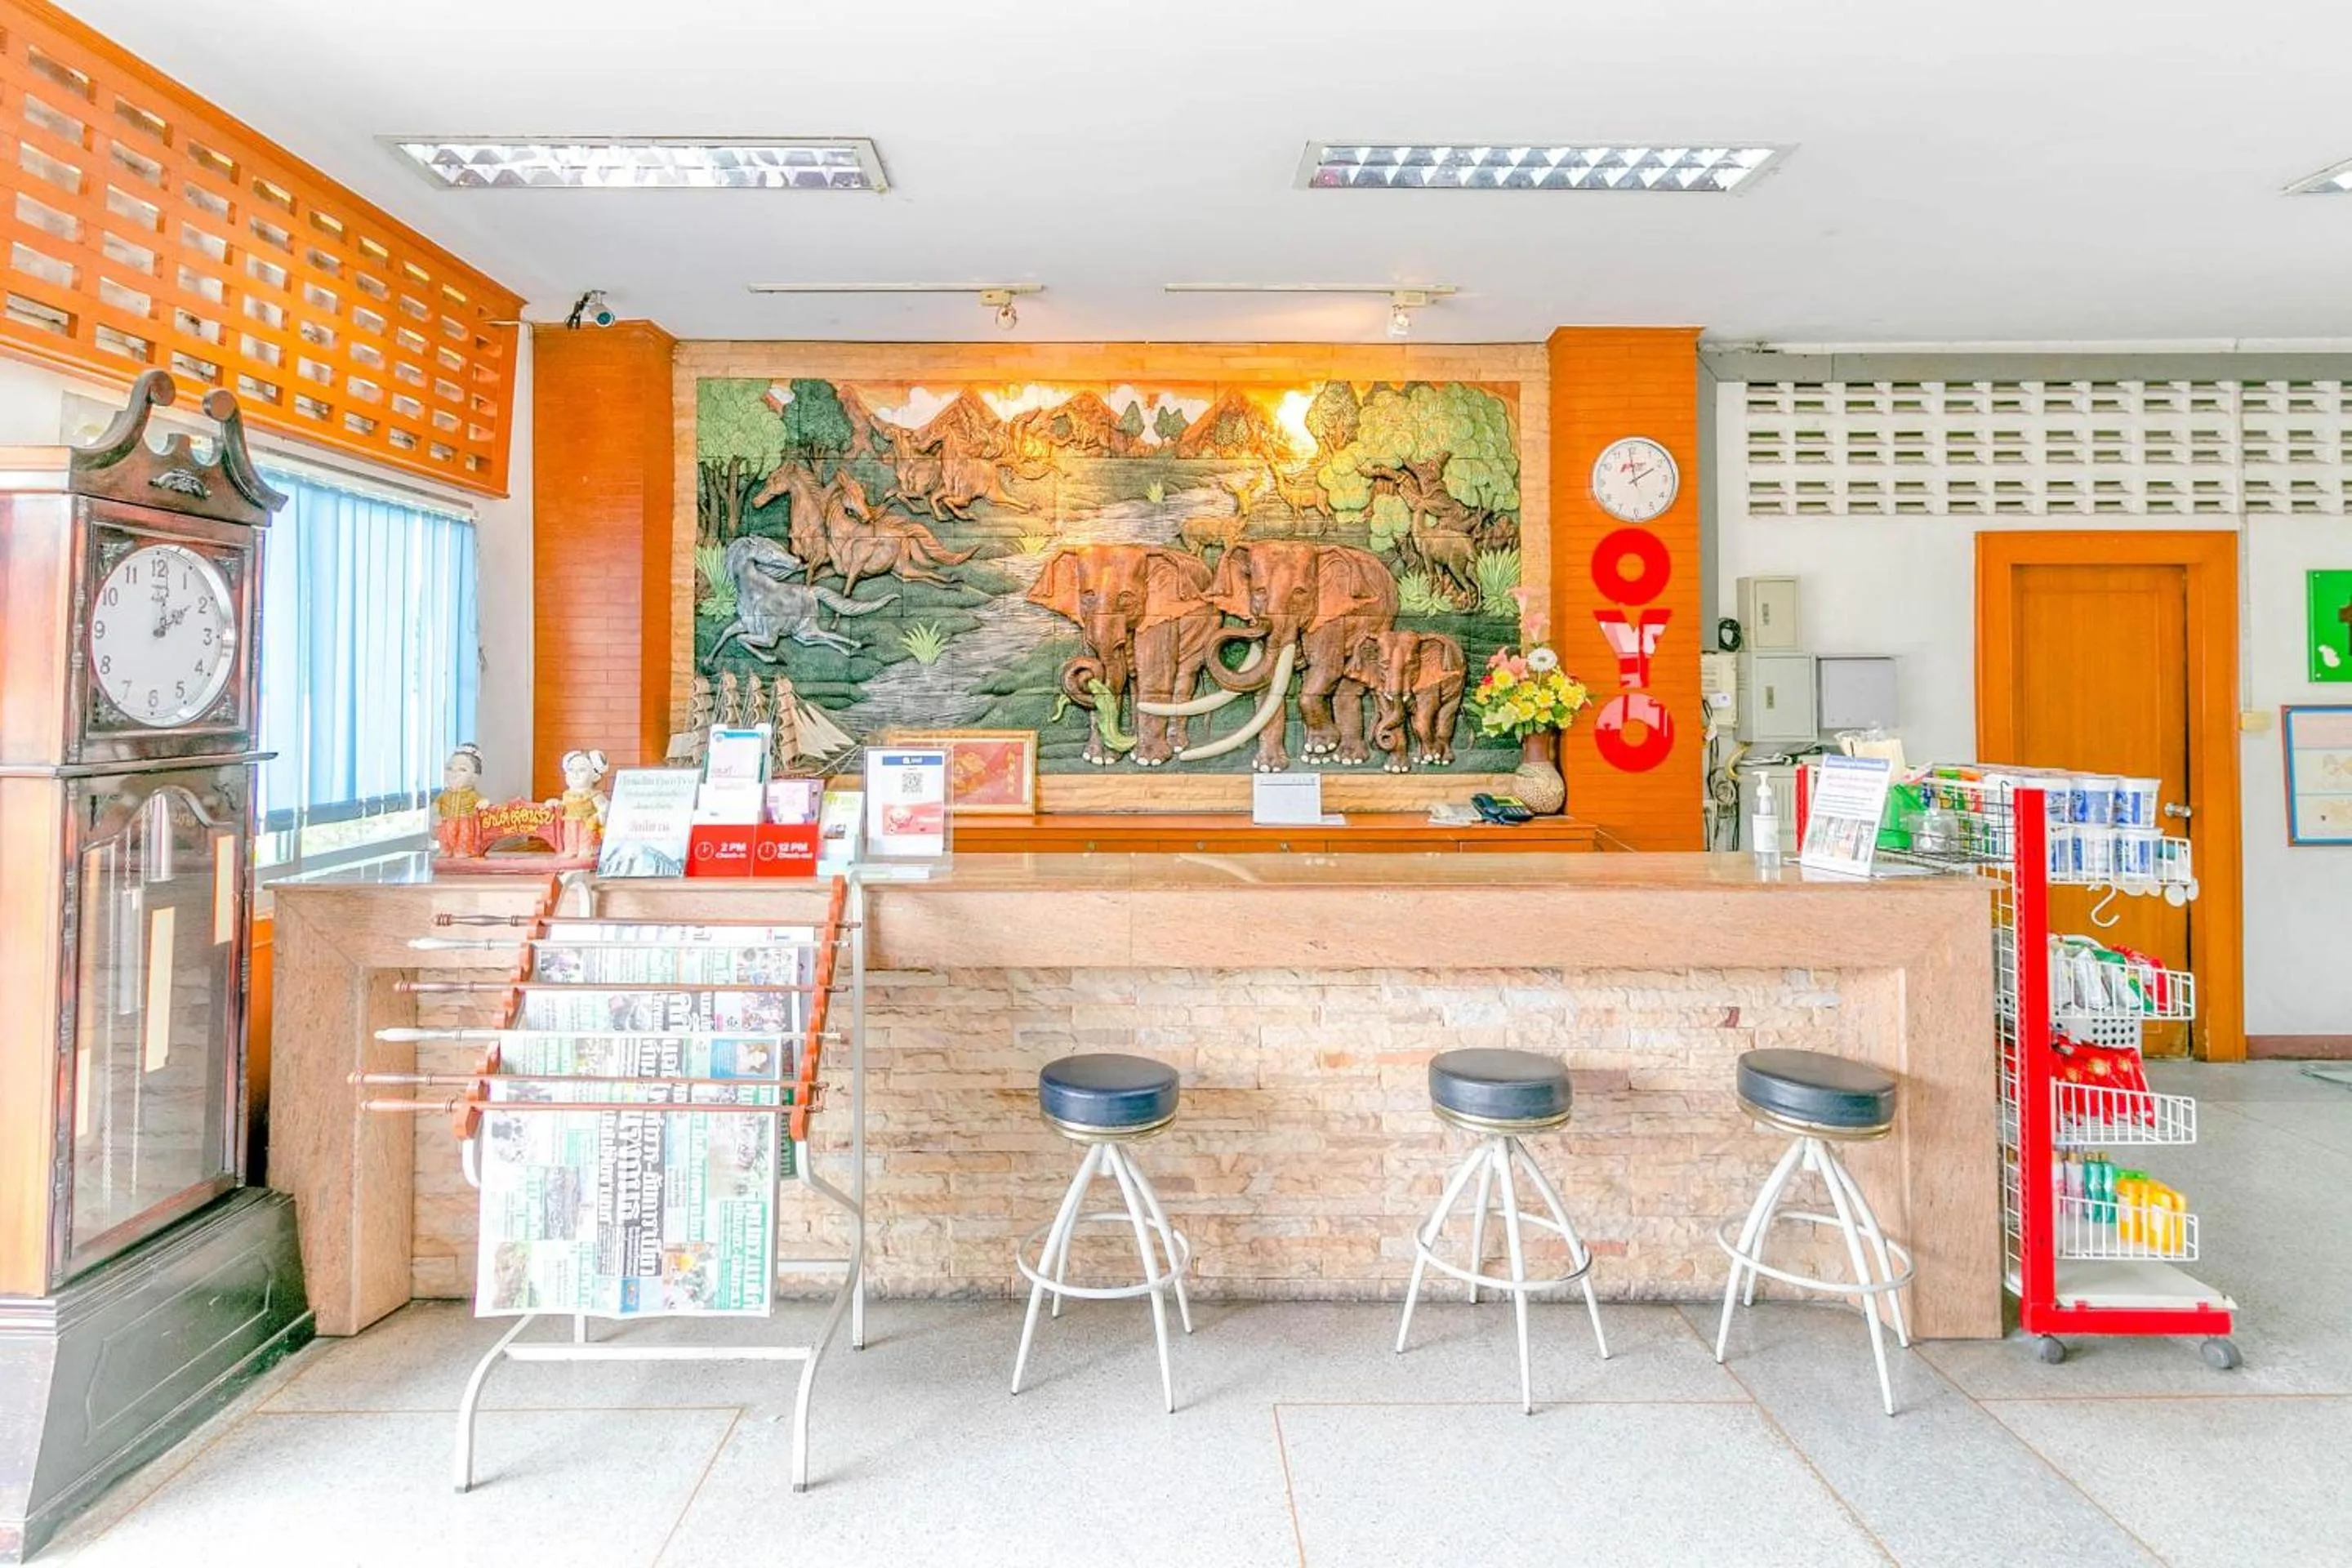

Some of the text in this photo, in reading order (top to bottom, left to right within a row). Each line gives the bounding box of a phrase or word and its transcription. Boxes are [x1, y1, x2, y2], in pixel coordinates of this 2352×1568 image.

[125, 565, 137, 584] 11
[151, 559, 165, 577] 12
[182, 573, 188, 590] 1
[102, 586, 118, 607] 10
[198, 596, 208, 614] 2
[94, 620, 105, 639] 9
[203, 628, 212, 646] 3
[1592, 528, 1674, 773] OYO
[99, 655, 111, 675] 8
[194, 658, 204, 675] 4
[122, 679, 132, 700] 7
[148, 689, 158, 708] 6
[175, 680, 185, 699] 5
[729, 842, 746, 852] PM
